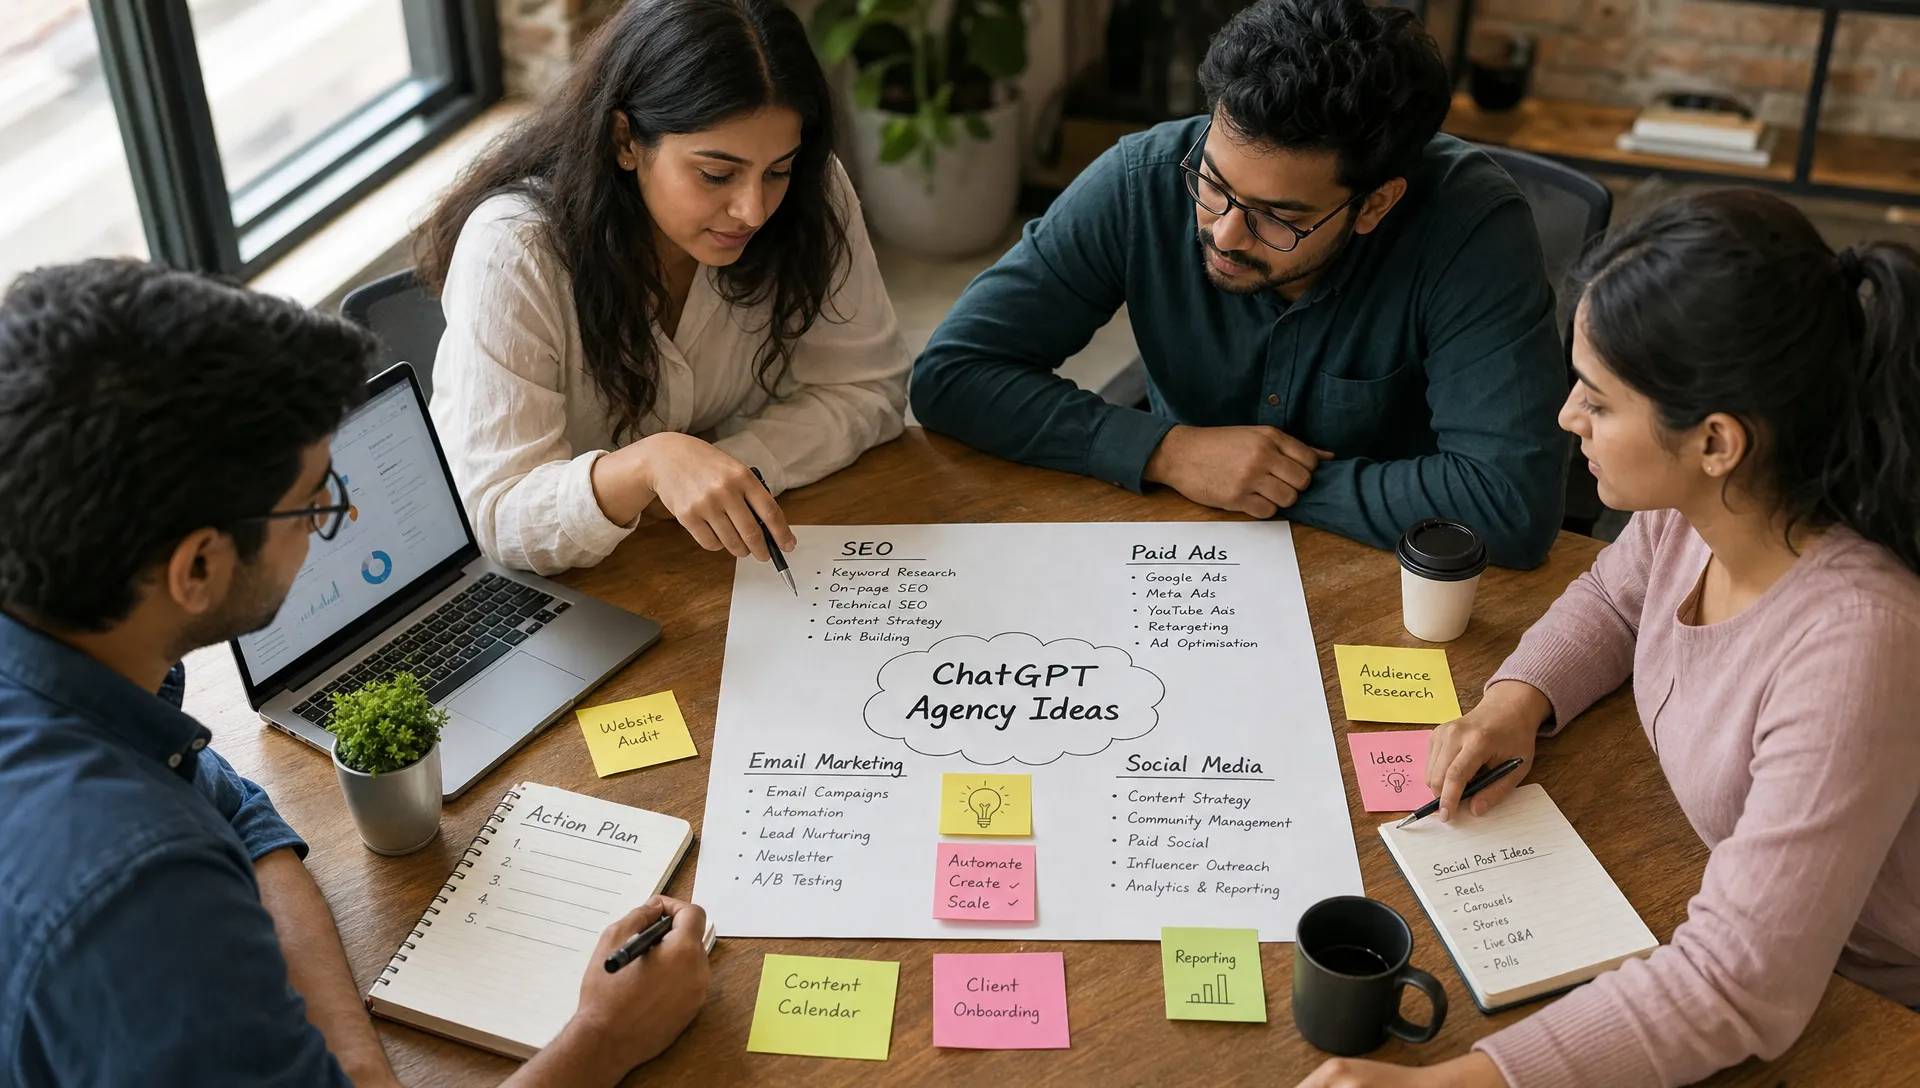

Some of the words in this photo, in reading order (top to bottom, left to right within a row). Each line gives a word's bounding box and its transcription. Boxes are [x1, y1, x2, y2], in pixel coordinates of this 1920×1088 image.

[841, 541, 894, 557] SEO
[1131, 544, 1177, 561] Paid
[1188, 545, 1228, 560] Ads
[832, 568, 890, 580] Keyword
[897, 568, 956, 578] Research
[1146, 572, 1193, 586] Google
[1201, 573, 1228, 582] Ads
[829, 583, 889, 596] On-page
[898, 583, 929, 594] SEO
[1146, 589, 1182, 599] Meta
[1190, 589, 1216, 599] Ads
[829, 599, 891, 610] Technical
[898, 599, 928, 610] SEO
[1148, 605, 1204, 616] YouTube
[826, 616, 880, 626] Content
[886, 616, 943, 629] Strategy
[1148, 622, 1229, 635] Retargeting
[824, 632, 852, 642] Link
[860, 632, 910, 646] Building
[1150, 638, 1169, 648] Ad
[1177, 638, 1258, 650] Optimisation
[932, 662, 1099, 688] ChatGPT
[1359, 664, 1431, 681] Audience
[1362, 684, 1434, 699] Research
[905, 694, 1017, 732] Agency
[1029, 696, 1120, 721] Ideas
[599, 713, 664, 734] Website
[618, 730, 660, 749] Audit
[748, 752, 806, 769] Email
[815, 753, 903, 778] Marketing
[1125, 754, 1188, 772] Social
[1201, 756, 1264, 774] Media
[1370, 751, 1413, 765] Ideas
[766, 785, 807, 797] Email
[815, 786, 889, 803] Campaigns
[1128, 790, 1186, 804] Content
[1192, 792, 1251, 810] Strategy
[762, 806, 844, 818] Automation
[525, 805, 587, 834] Action
[596, 821, 639, 845] Plan
[1127, 811, 1202, 831] Community
[1208, 815, 1292, 832] Management
[512, 838, 522, 850] 1.
[759, 827, 795, 839] Lead
[802, 828, 871, 846] Nurturing
[1128, 834, 1159, 847] Paid
[1167, 836, 1209, 849] Social
[500, 856, 512, 869] 2.
[755, 850, 833, 863] Newsletter
[948, 854, 1023, 870] Automate
[1126, 857, 1199, 871] Influencer
[1206, 859, 1270, 872] Outreach
[1433, 857, 1470, 877] Social
[1474, 853, 1497, 867] Post
[1499, 844, 1535, 862] Ideas
[488, 874, 501, 887] 3.
[751, 872, 783, 887] A/B
[793, 873, 843, 892] Testing
[949, 875, 1001, 889] Create
[1126, 879, 1190, 897] Analytics
[1197, 881, 1207, 894] &
[1215, 881, 1280, 900] Reporting
[1454, 882, 1485, 897] Reels
[477, 893, 489, 906] 4.
[948, 895, 991, 909] Scale
[1463, 894, 1513, 914] Carousels
[464, 912, 477, 925] 5.
[1473, 916, 1509, 933] Stories
[1483, 938, 1506, 951] Live
[1507, 929, 1534, 945] Q&A
[1175, 949, 1236, 970] Reporting
[1493, 955, 1520, 970] Polls
[784, 973, 862, 992] Content
[966, 977, 1020, 993] Client
[778, 999, 861, 1019] Calendar
[953, 1002, 1040, 1025] Onboarding
